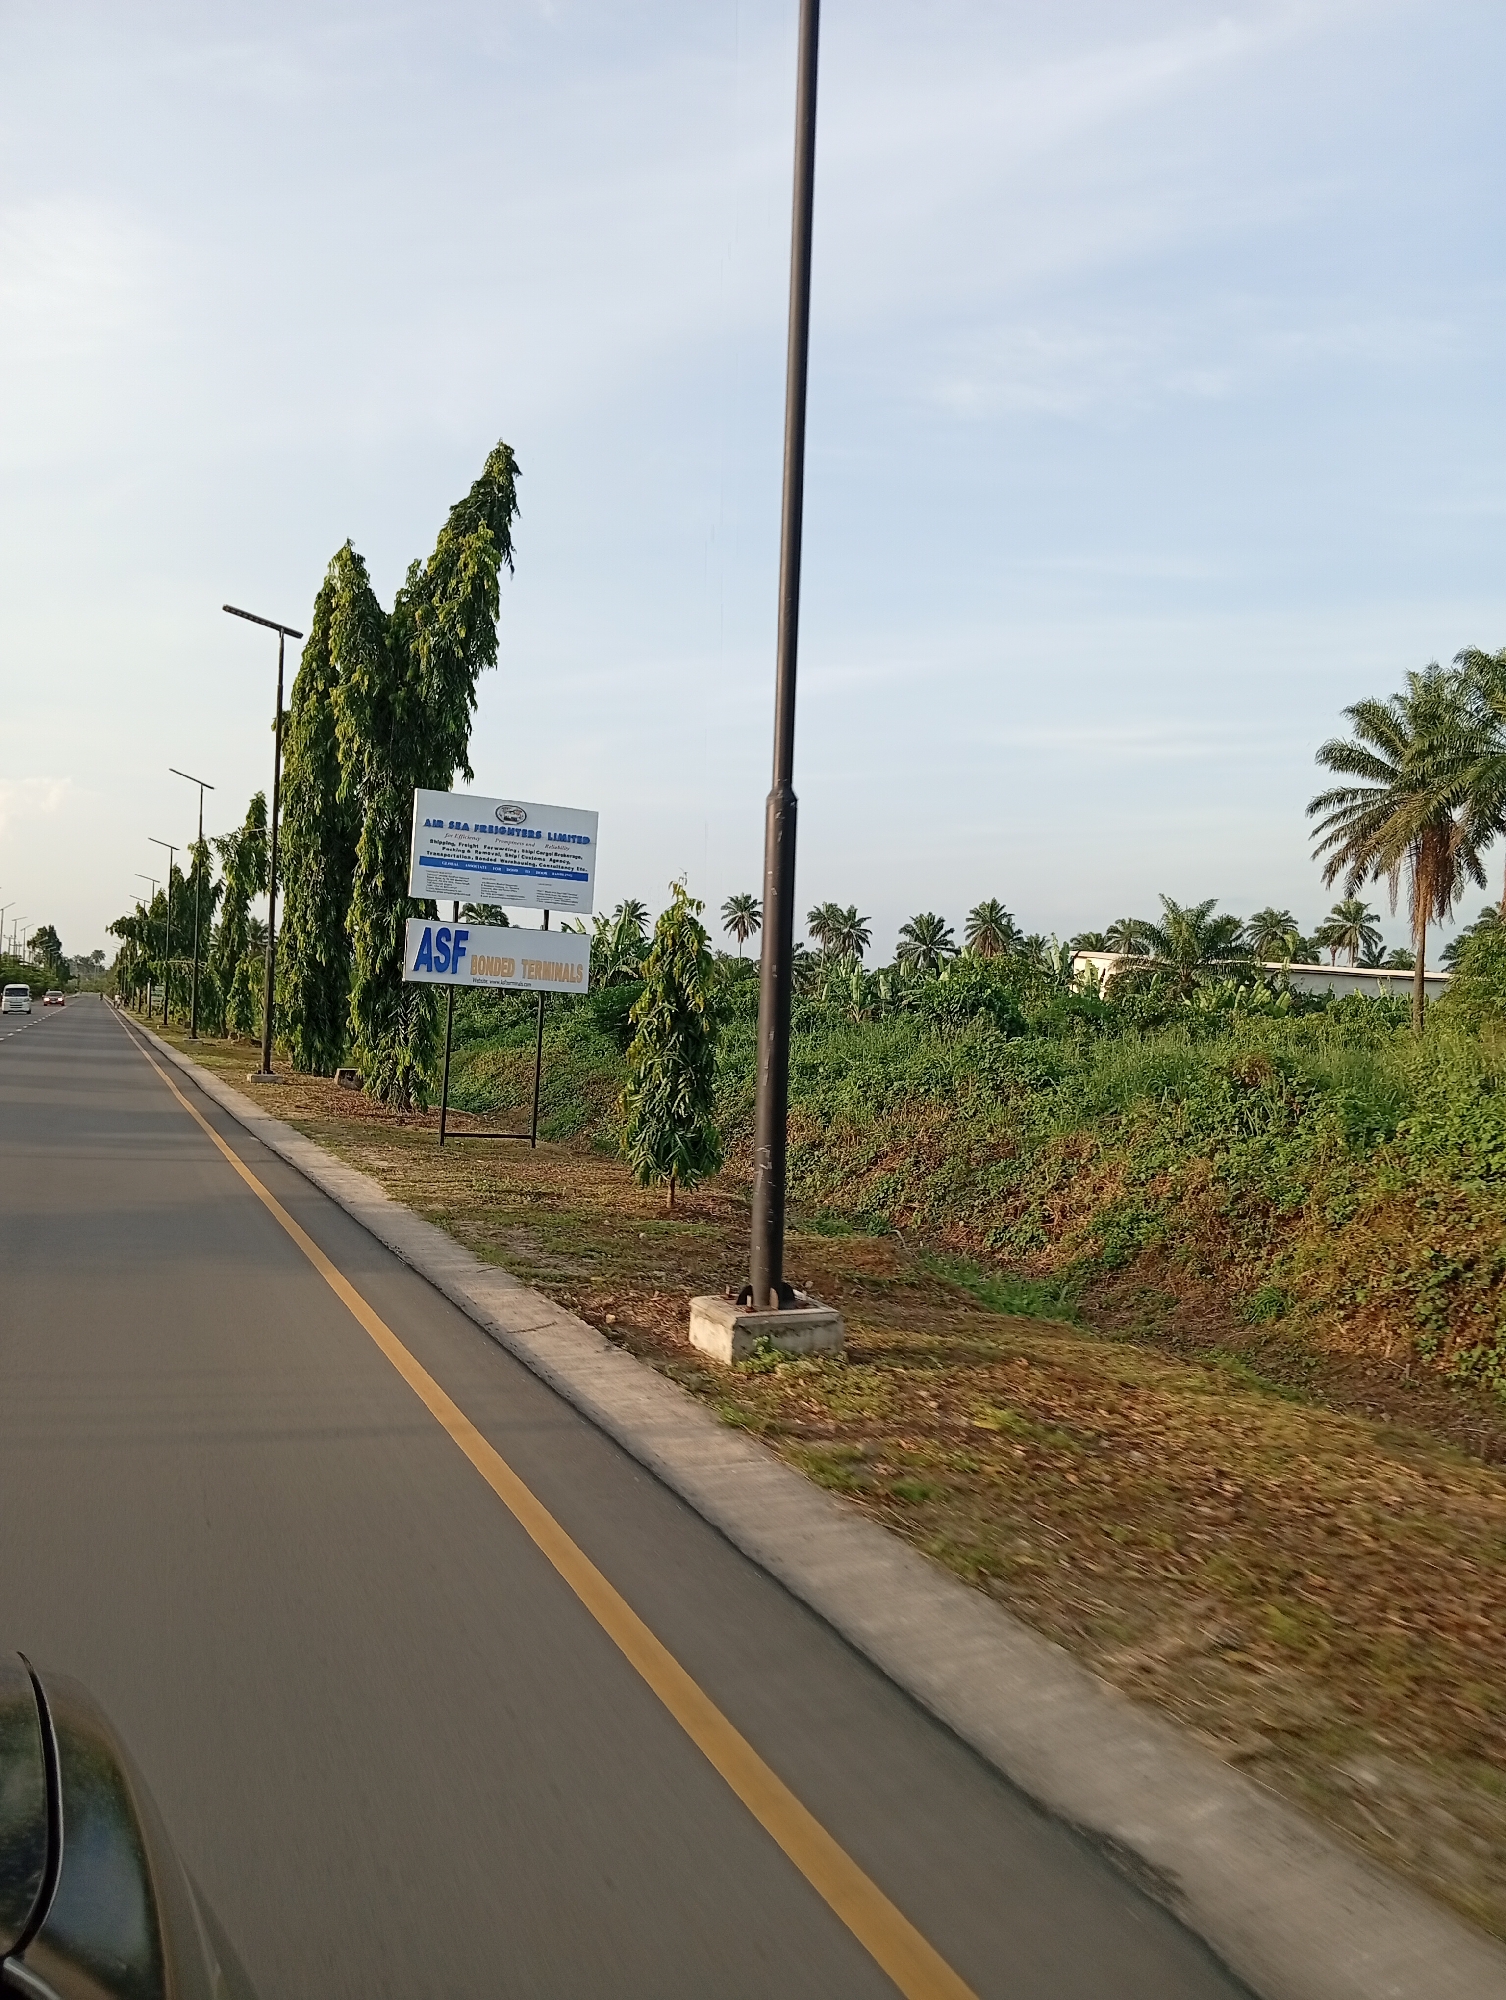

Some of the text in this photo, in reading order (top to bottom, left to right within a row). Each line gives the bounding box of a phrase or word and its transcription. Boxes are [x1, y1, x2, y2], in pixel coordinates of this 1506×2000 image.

[423, 818, 590, 844] AIR SEA FREIGHTERS LIMITED
[412, 926, 584, 984] ASF BONDED TERMINALS
